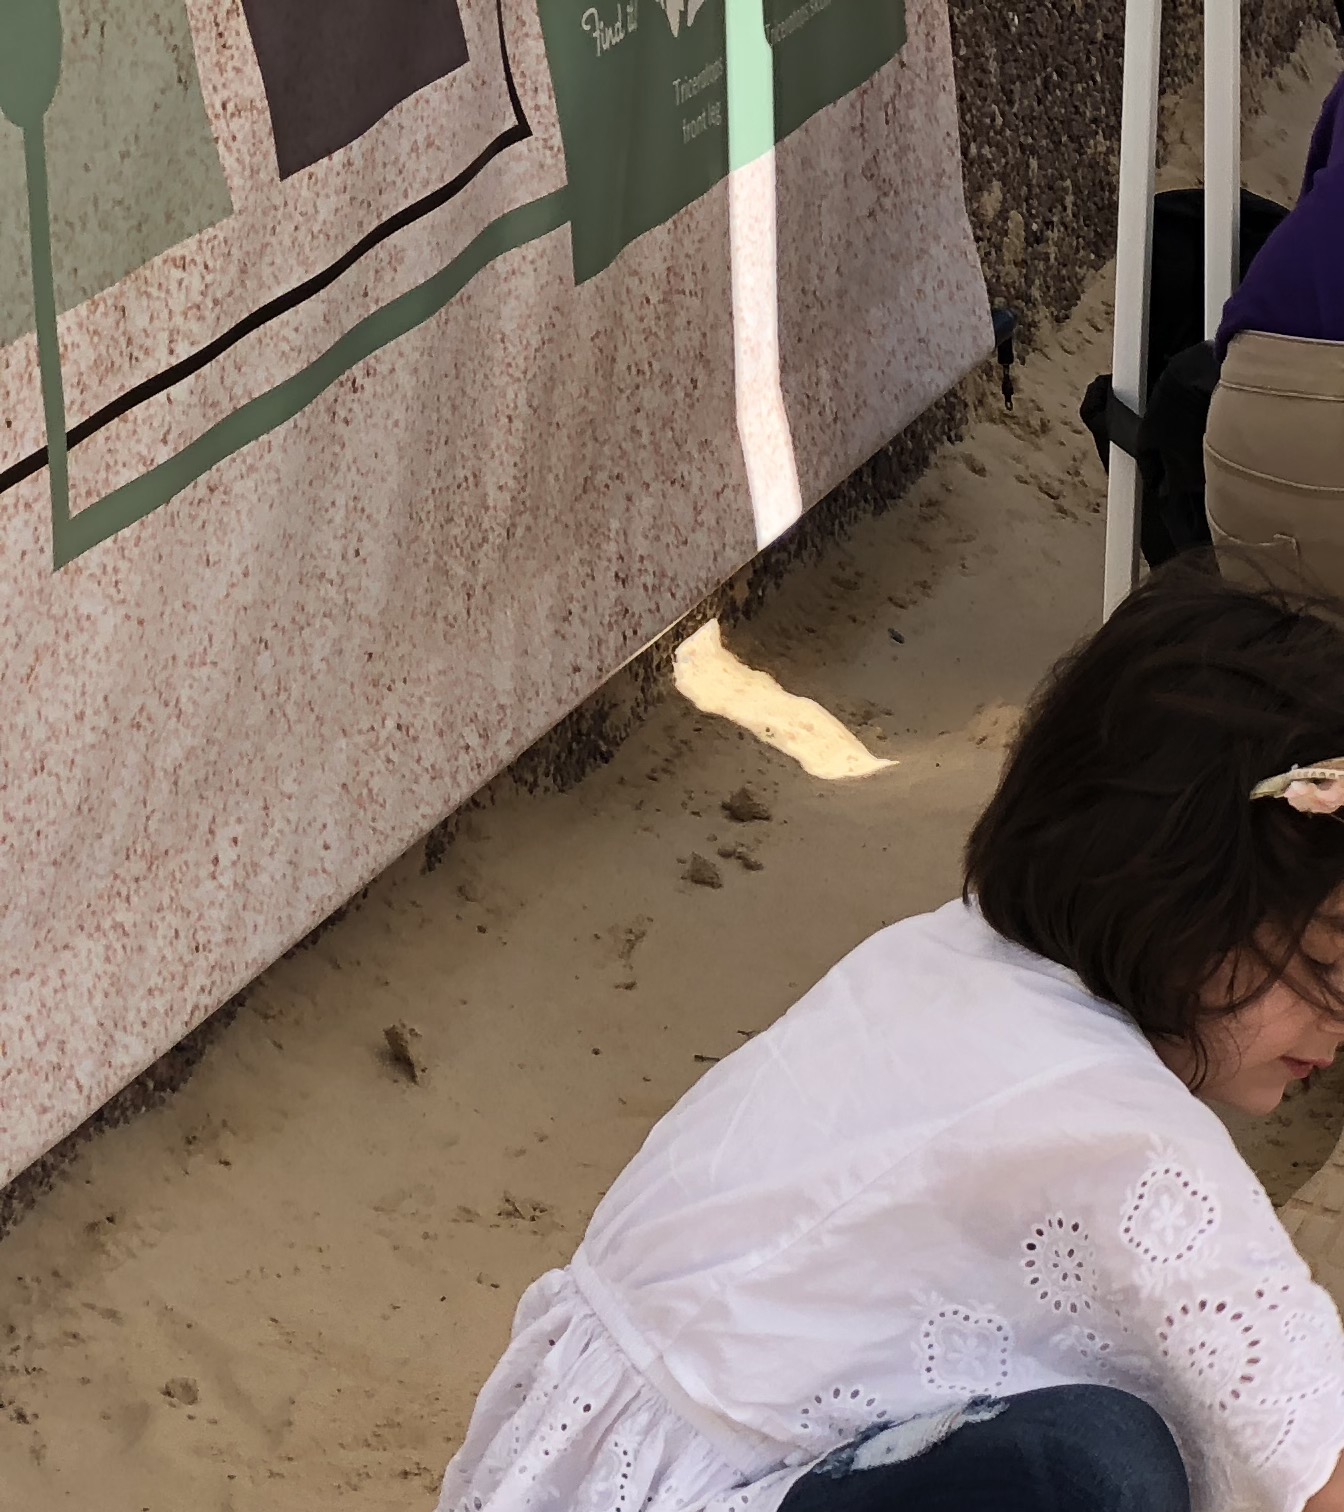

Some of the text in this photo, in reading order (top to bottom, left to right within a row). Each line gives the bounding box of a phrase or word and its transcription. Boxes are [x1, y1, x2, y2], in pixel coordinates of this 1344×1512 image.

[581, 3, 626, 57] Find
[682, 101, 722, 144] front leg
